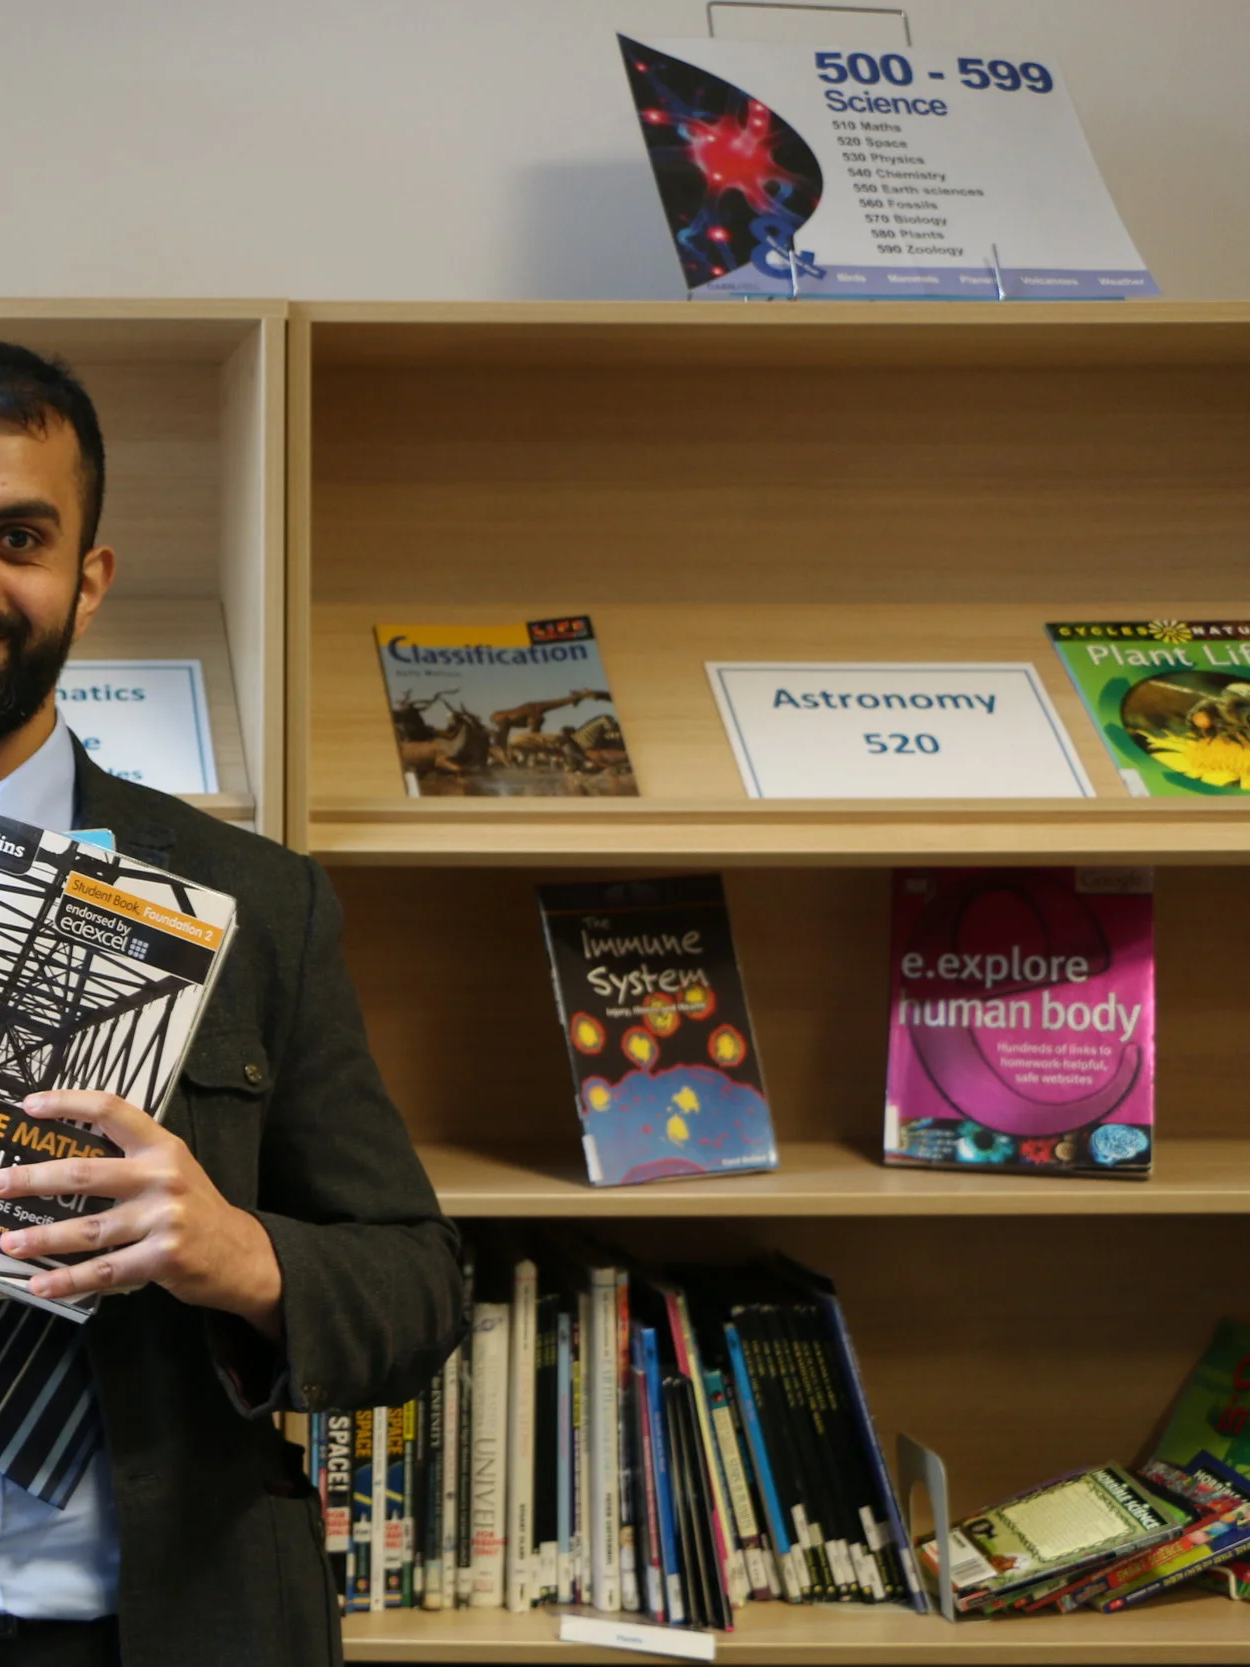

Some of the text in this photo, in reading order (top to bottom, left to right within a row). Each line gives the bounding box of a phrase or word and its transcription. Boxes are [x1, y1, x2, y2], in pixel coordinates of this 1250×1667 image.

[815, 52, 1054, 94] 500 - 599
[824, 89, 948, 116] Science
[831, 120, 902, 133] 510 Maths
[837, 136, 908, 149] 520 Space
[842, 152, 925, 166] 530 Physics
[847, 168, 946, 182] 540 Chemistry
[853, 183, 985, 197] 550 Earth sciences
[859, 199, 938, 211] 560 Fossils
[865, 213, 947, 227] 570 Biology
[871, 229, 944, 241] 580 Plants
[877, 244, 964, 257] 590 Zoology
[1058, 625, 1149, 637] CYCLES
[387, 635, 589, 666] Classification
[1086, 642, 1193, 667] Plant
[772, 688, 996, 714] Astronomy
[864, 732, 940, 755] 520
[65, 902, 133, 937] endorsed by
[71, 878, 111, 904] Student
[142, 906, 205, 938] Foundation
[204, 928, 214, 941] 2
[60, 916, 130, 953] edexcel
[582, 916, 610, 929] The
[580, 929, 704, 960] Immune
[901, 946, 1090, 989] e.explore
[586, 963, 710, 1005] System
[899, 988, 1143, 1043] human body
[996, 1041, 1112, 1056] Hundreds of links to
[1015, 1071, 1093, 1085] safe websites
[354, 1409, 372, 1458] SPACE
[386, 1407, 404, 1456] SPACE
[328, 1415, 349, 1492] SPACE!
[1093, 1468, 1160, 1531] HORRIBLE SCIENCE
